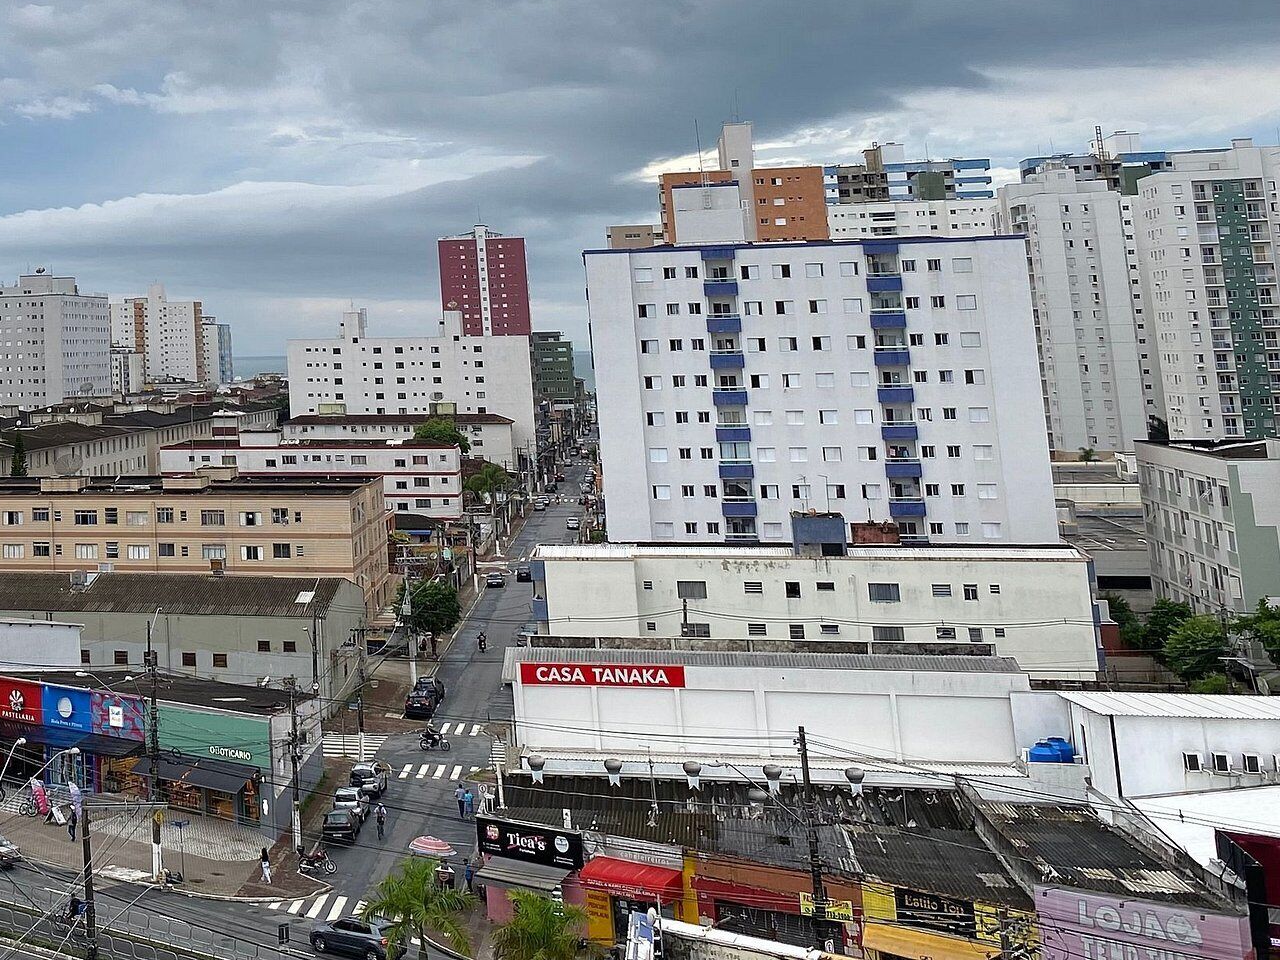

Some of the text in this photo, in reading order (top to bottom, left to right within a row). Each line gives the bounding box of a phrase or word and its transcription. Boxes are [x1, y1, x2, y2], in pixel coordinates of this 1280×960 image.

[536, 667, 670, 685] CASA TANAKA
[1, 710, 35, 722] PASTELARIA
[507, 833, 545, 851] Tica's
